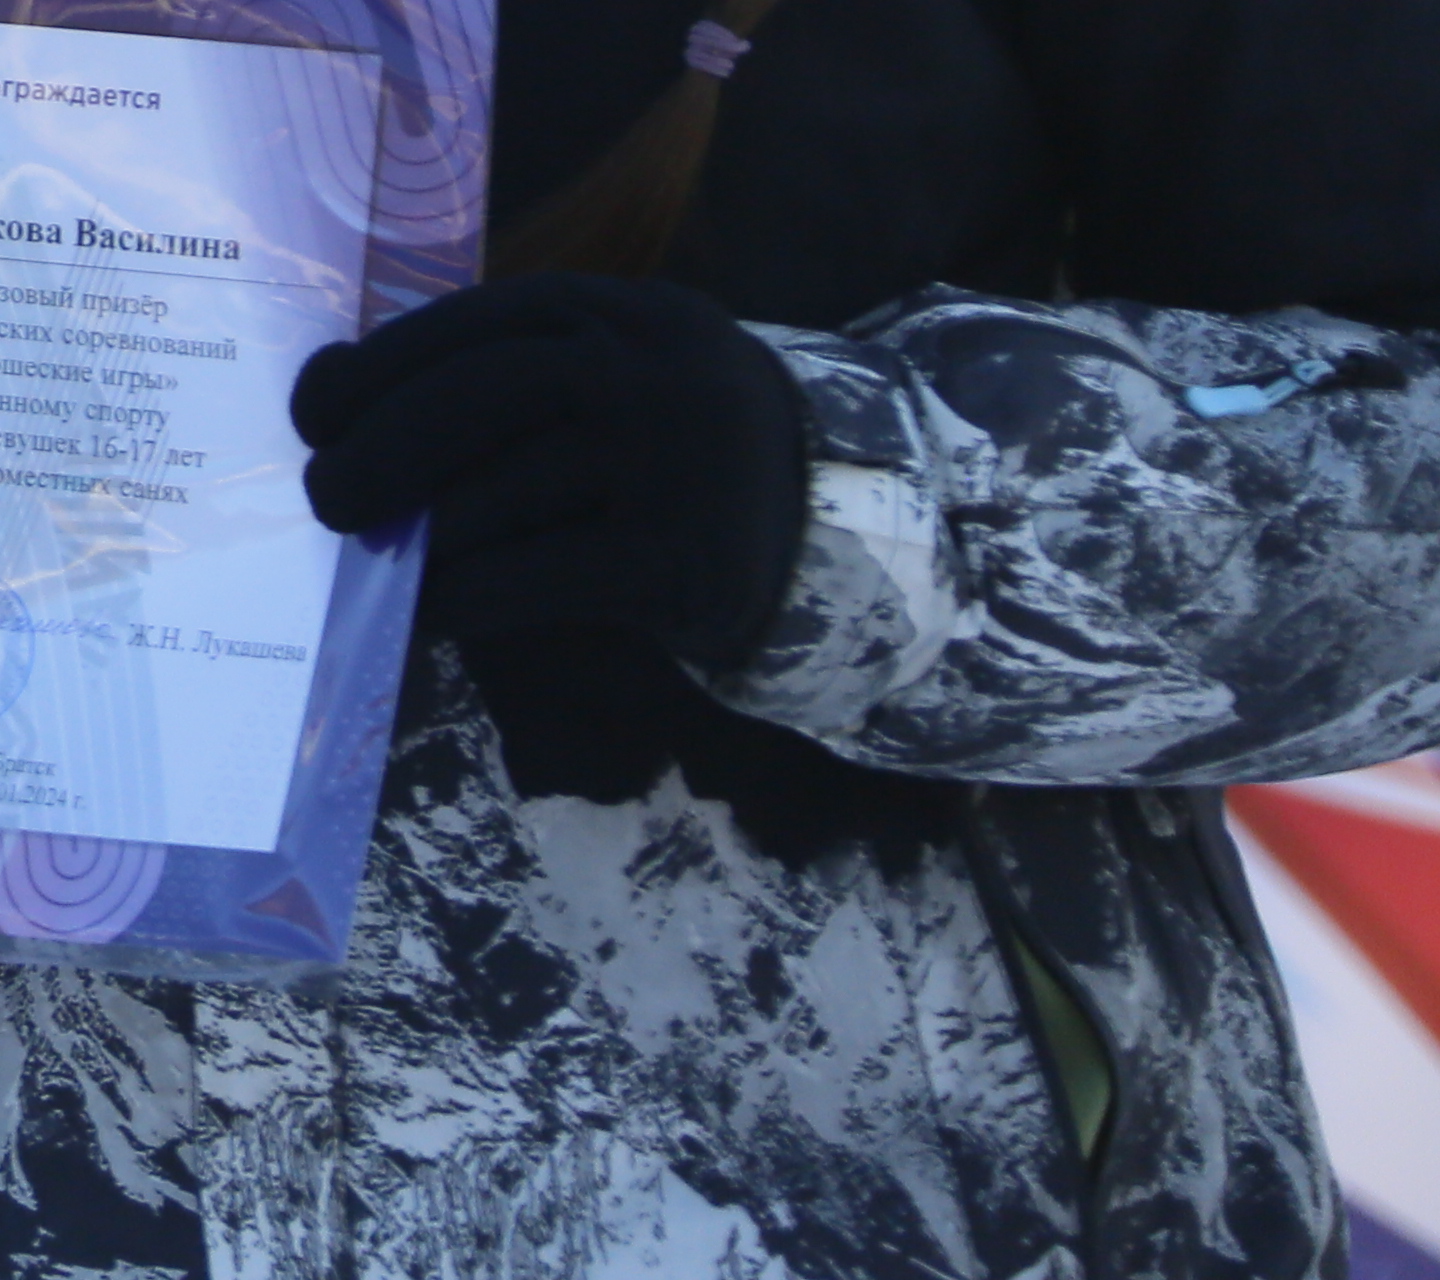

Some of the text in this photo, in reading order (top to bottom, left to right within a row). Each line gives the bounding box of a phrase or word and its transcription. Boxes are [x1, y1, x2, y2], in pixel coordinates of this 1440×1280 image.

[74, 218, 239, 259] Василина
[80, 292, 168, 323] призёр
[61, 328, 235, 360] соревнований
[100, 367, 177, 394] игры»
[84, 403, 166, 433] спорту
[91, 434, 157, 462] 16-17
[164, 448, 205, 467] лет
[119, 479, 189, 505] санях
[127, 623, 184, 650] Ж.Н.
[192, 629, 308, 662] Лукашева
